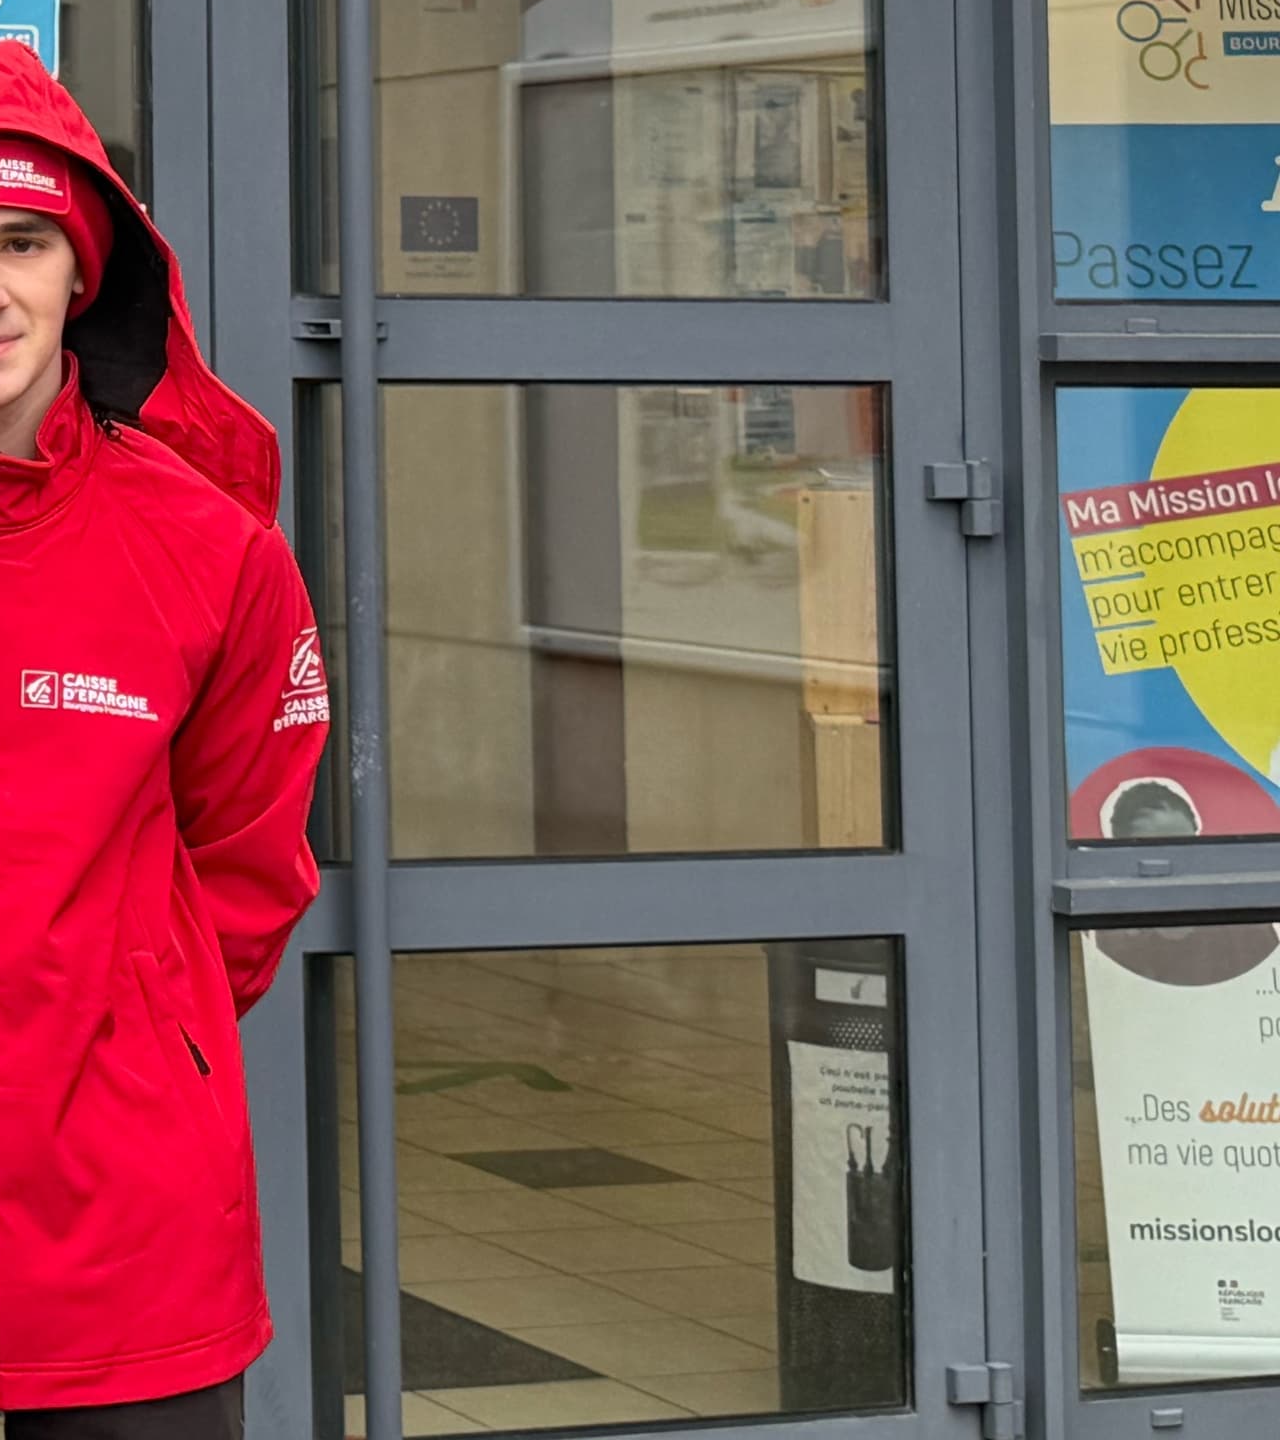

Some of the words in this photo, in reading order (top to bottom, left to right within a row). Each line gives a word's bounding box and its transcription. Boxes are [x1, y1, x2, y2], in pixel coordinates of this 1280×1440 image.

[1053, 231, 1257, 289] Passez
[1067, 496, 1121, 529] Ma
[1128, 479, 1258, 520] Mission
[1092, 587, 1164, 625] pour
[1178, 570, 1278, 607] entrer
[1101, 634, 1148, 664] vie
[62, 673, 118, 692] CAISSE
[62, 687, 148, 711] D'EPARGNE
[1128, 1143, 1168, 1165] ma
[1177, 1139, 1214, 1166] vie
